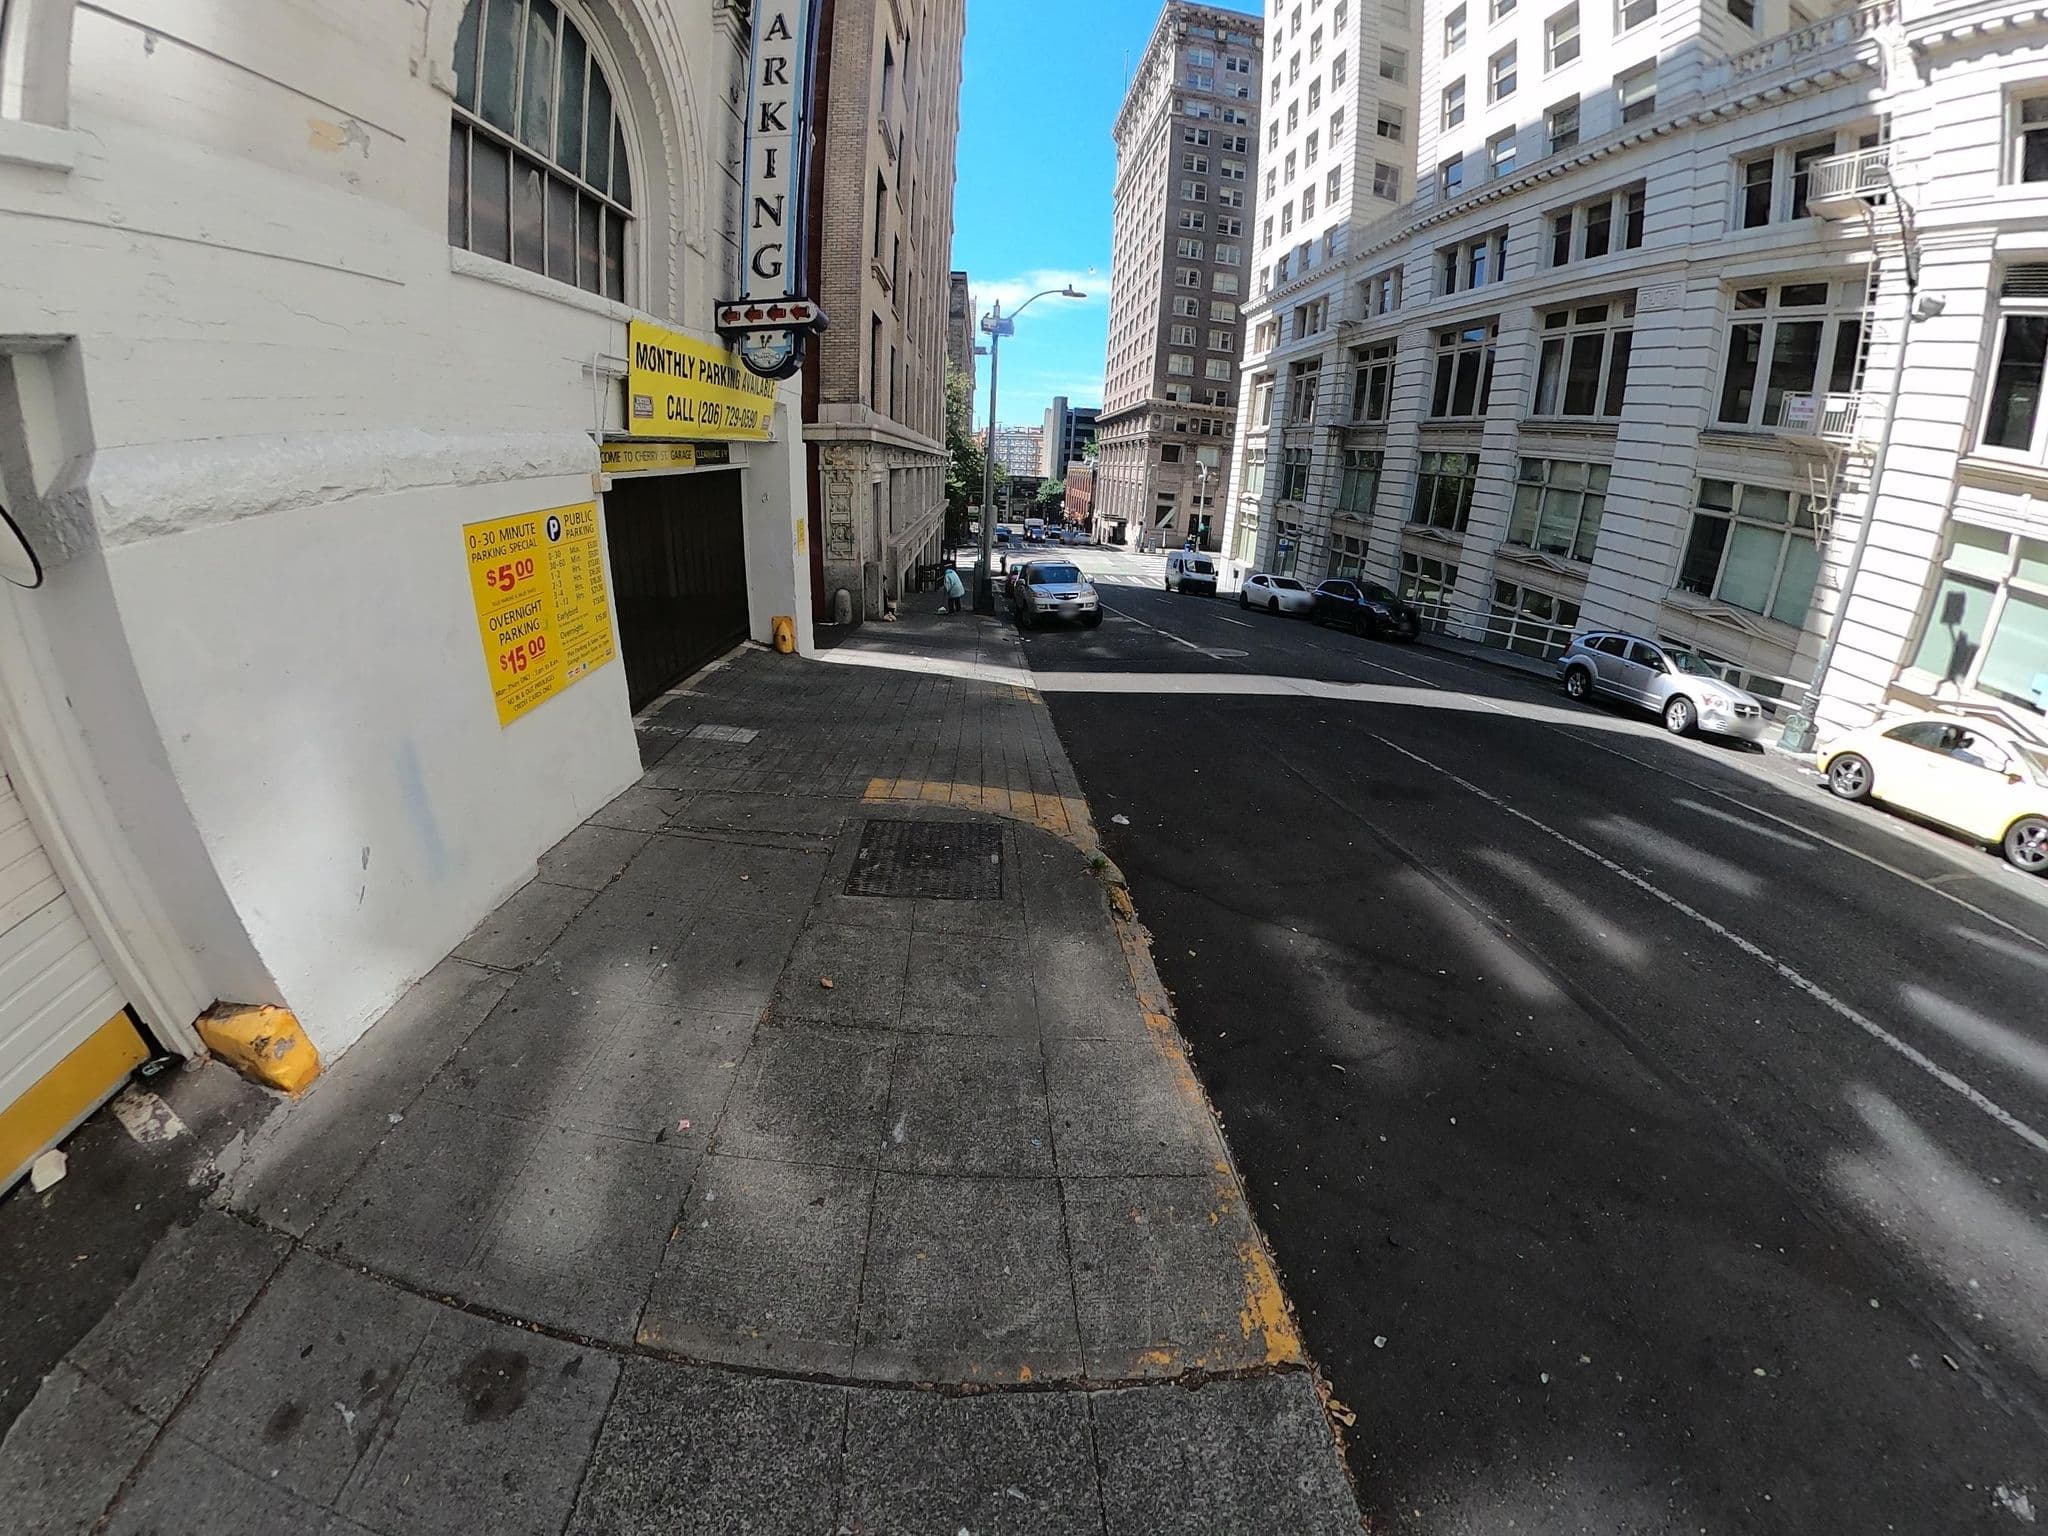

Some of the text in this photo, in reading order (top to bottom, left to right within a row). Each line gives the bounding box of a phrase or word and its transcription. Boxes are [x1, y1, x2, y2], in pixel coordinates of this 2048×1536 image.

[635, 342, 775, 399] MONTHLY PARKING AVAILABLE
[667, 395, 694, 422] CALL
[698, 400, 723, 430] (206)
[623, 451, 633, 463] TO
[670, 449, 692, 461] GARAGE
[564, 509, 593, 527] PUBLIC
[499, 522, 536, 542] MINUTE
[565, 523, 595, 539] PARKING
[471, 538, 538, 563] PARKING SPECIAL
[489, 600, 543, 632] OVERNIGHT
[499, 618, 540, 646] PARKING
